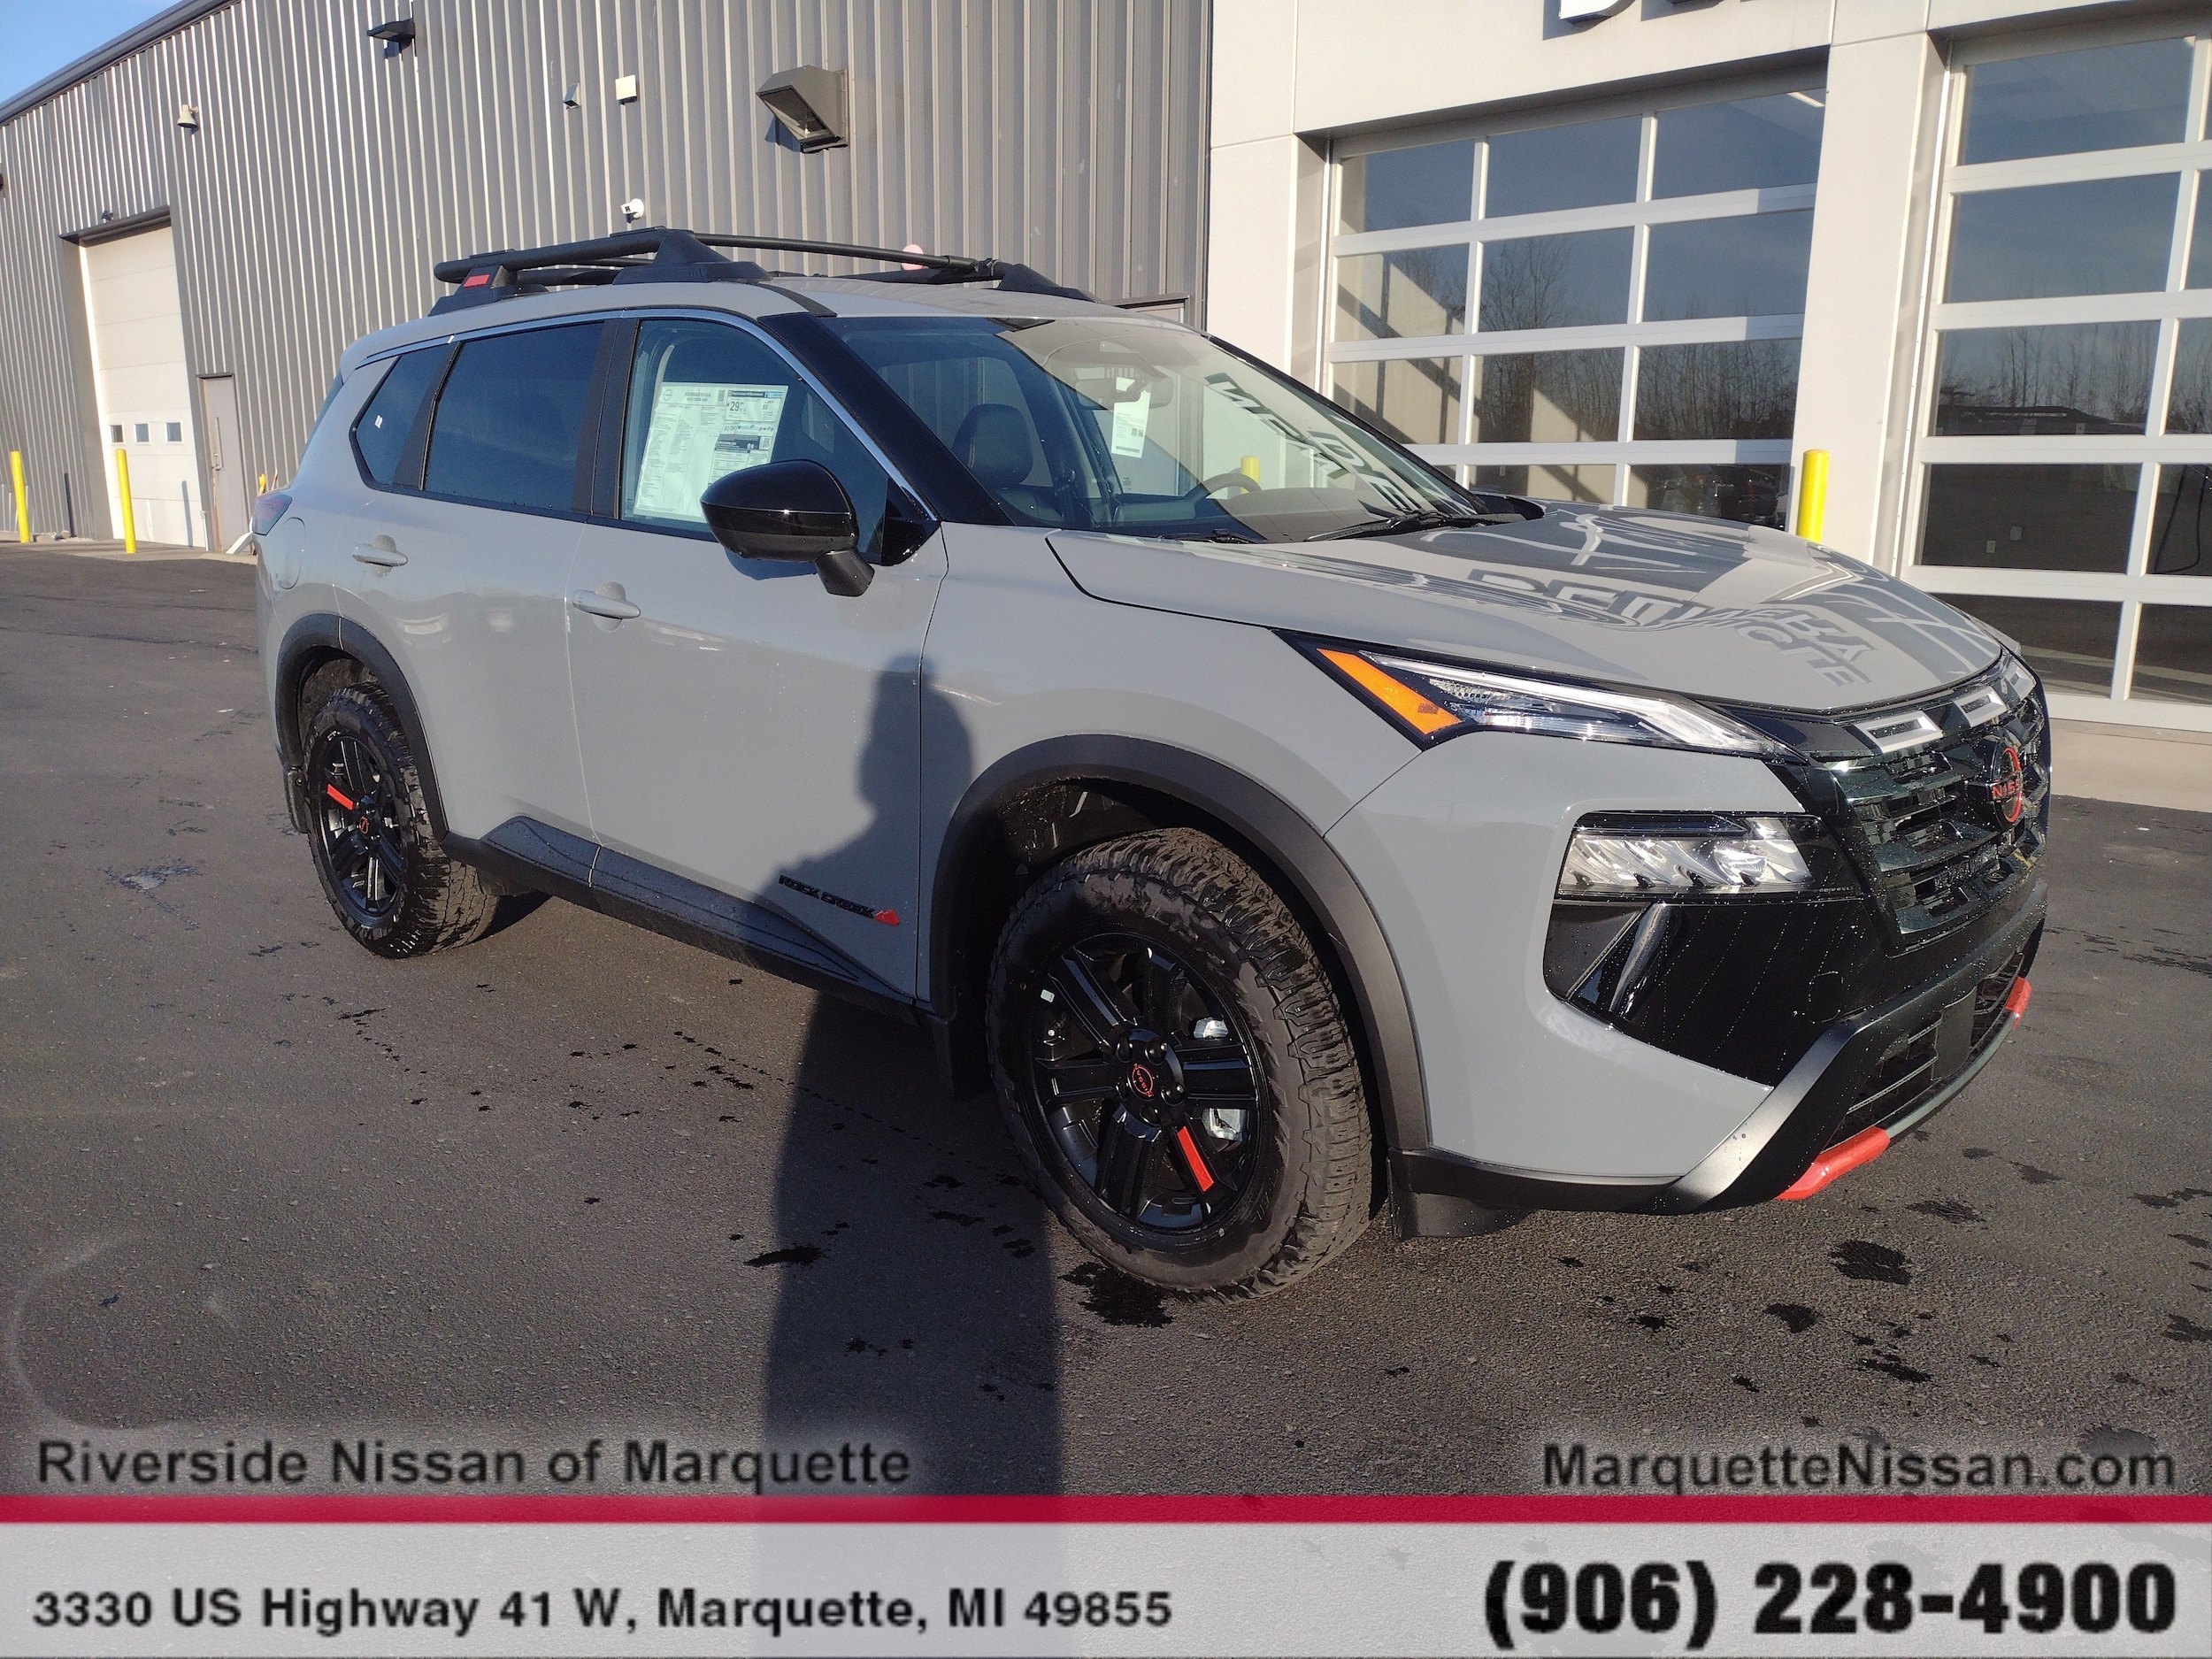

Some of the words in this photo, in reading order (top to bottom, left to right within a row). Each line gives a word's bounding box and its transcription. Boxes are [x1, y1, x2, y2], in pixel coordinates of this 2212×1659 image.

[730, 401, 740, 411] 29
[779, 874, 820, 899] ROCK
[821, 891, 875, 918] CREEK
